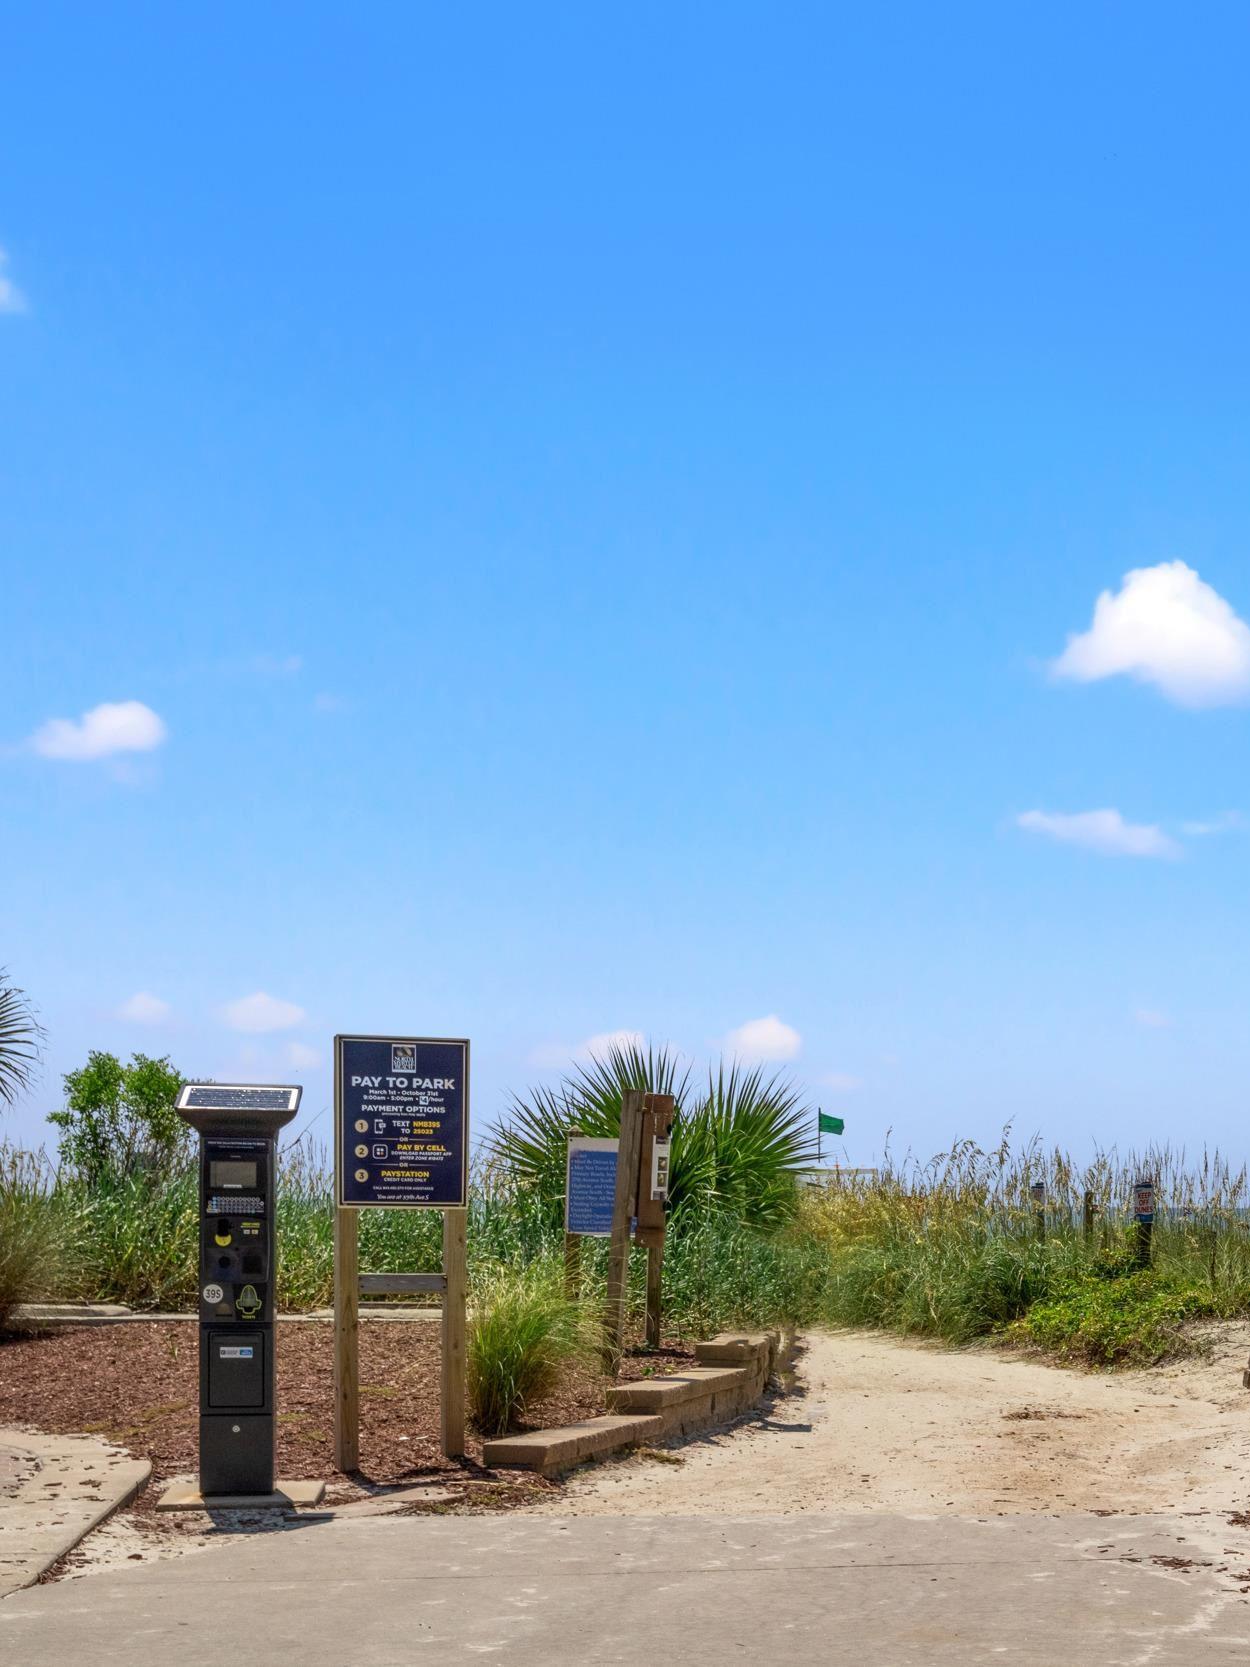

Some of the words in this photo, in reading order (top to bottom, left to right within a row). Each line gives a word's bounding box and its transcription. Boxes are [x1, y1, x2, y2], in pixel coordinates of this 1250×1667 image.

[352, 1076, 382, 1087] PAY
[386, 1078, 408, 1088] TO
[413, 1079, 455, 1090] PARK
